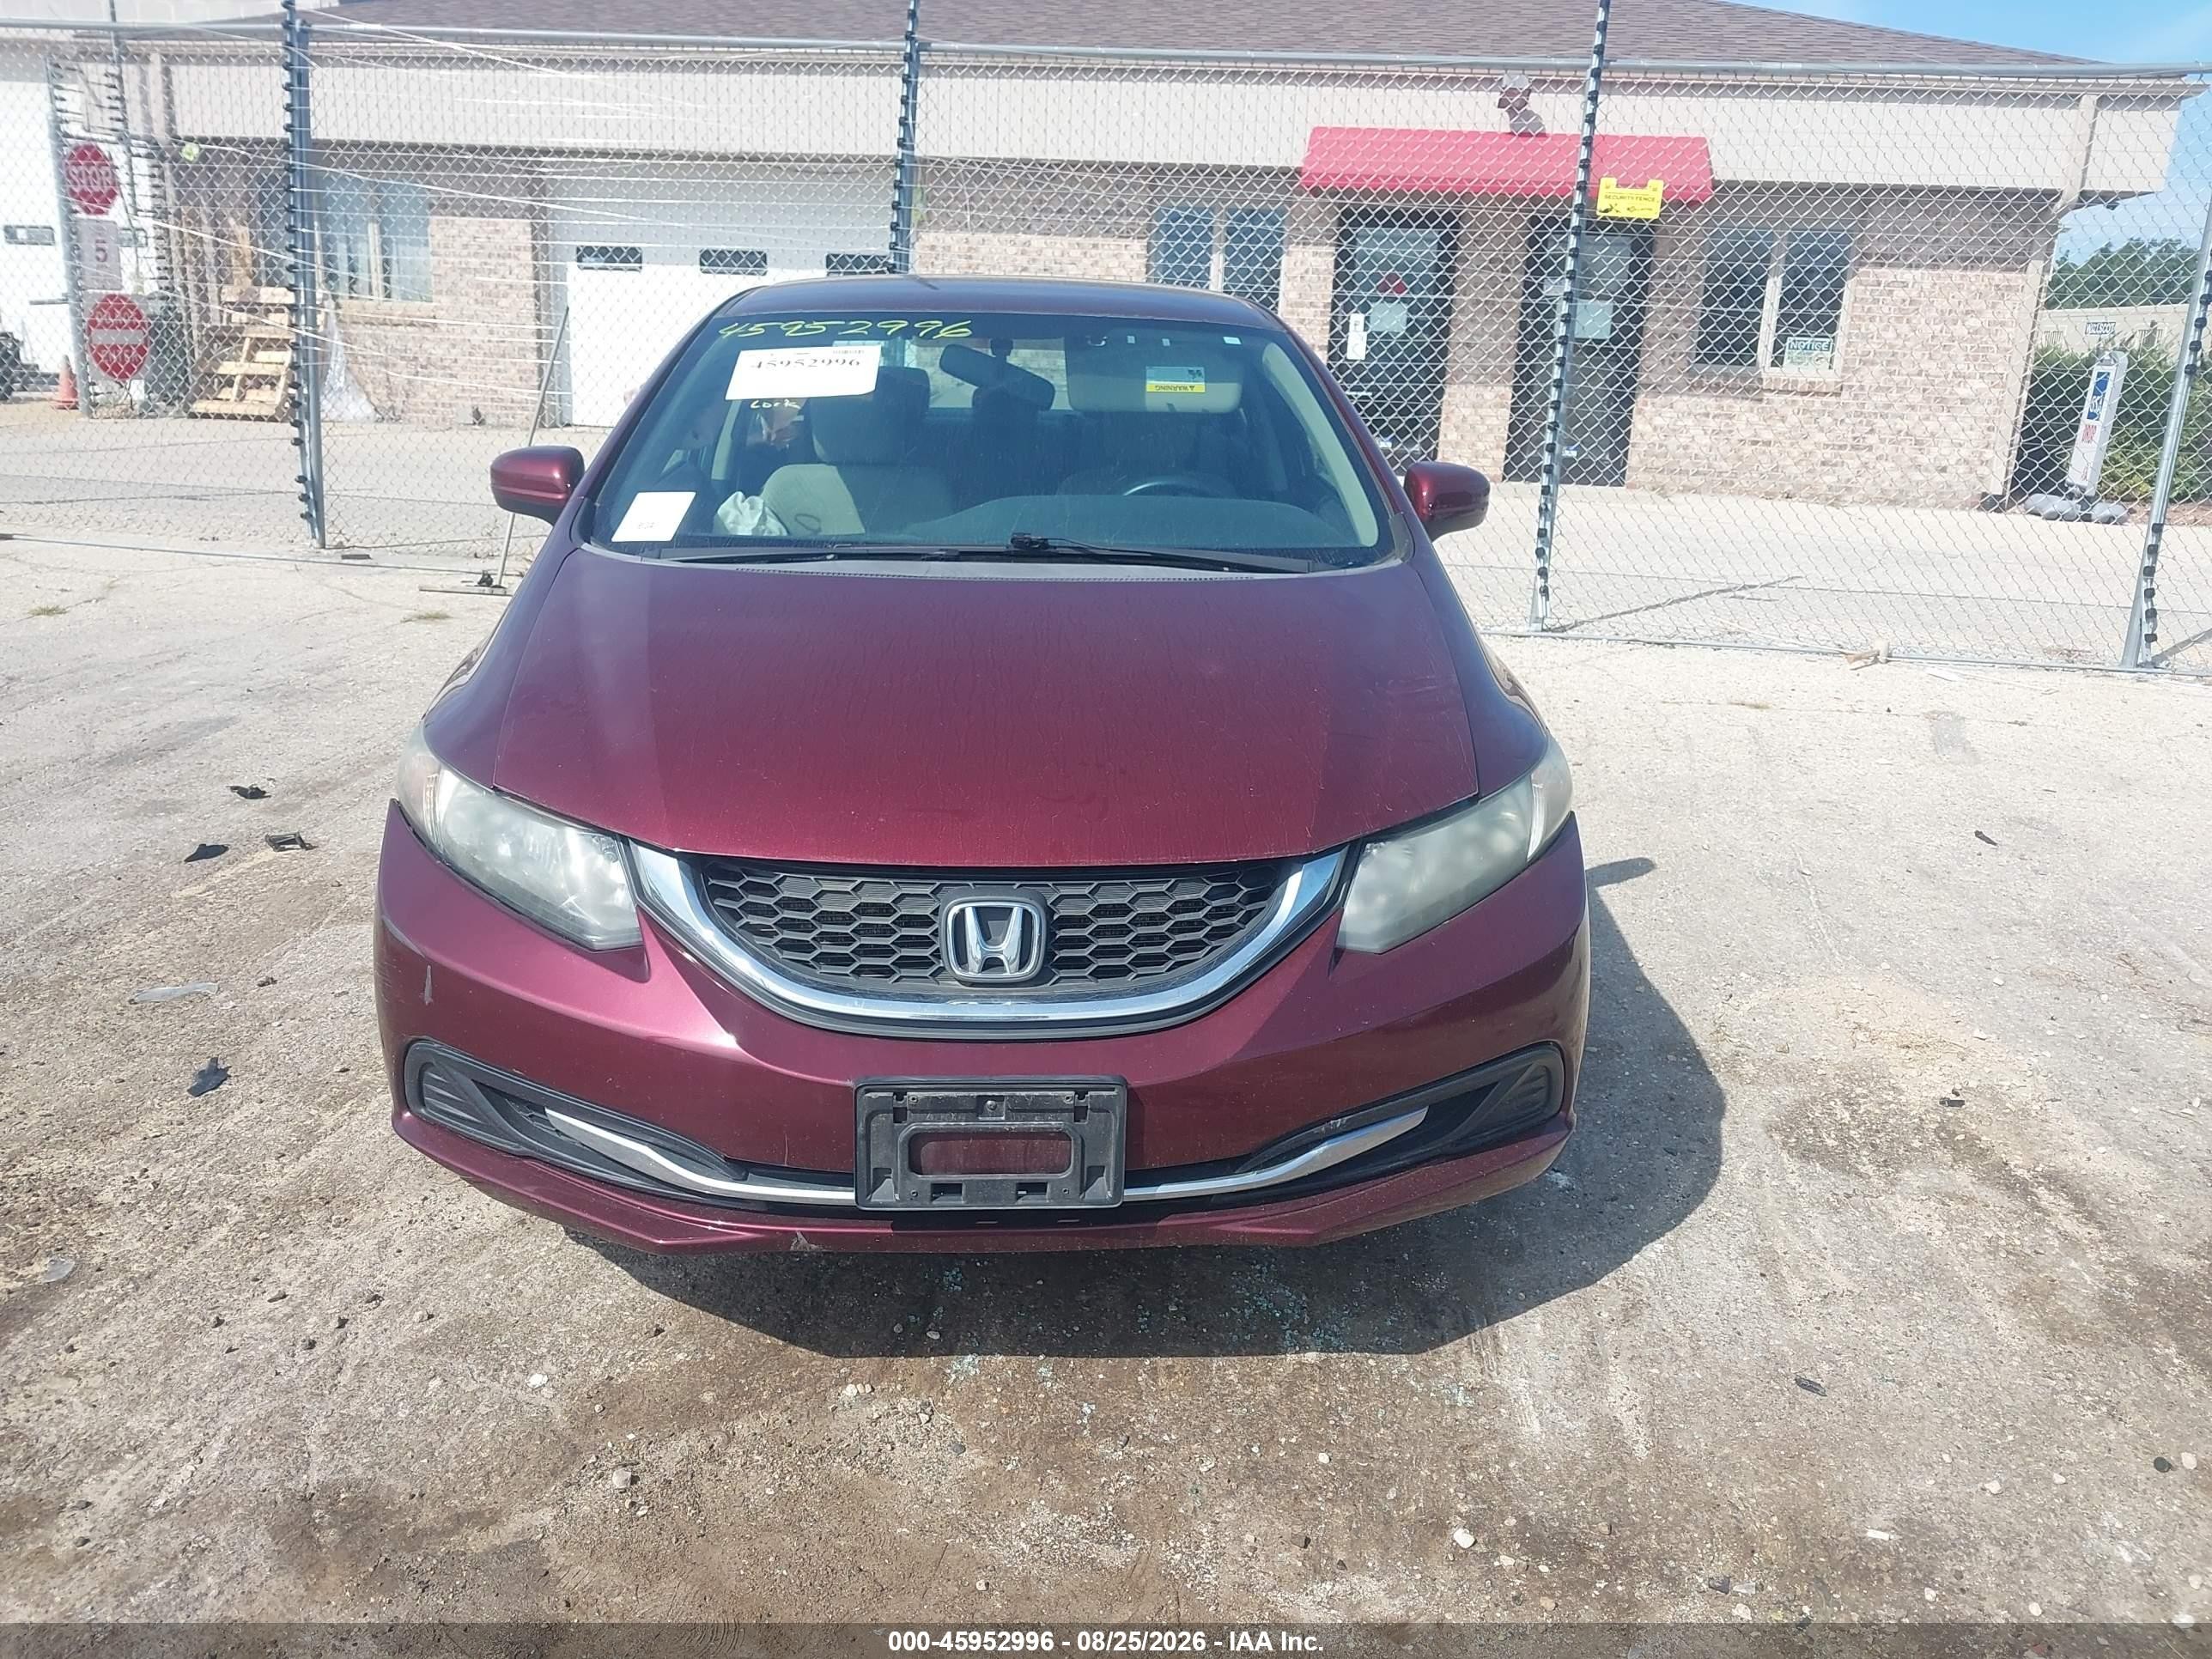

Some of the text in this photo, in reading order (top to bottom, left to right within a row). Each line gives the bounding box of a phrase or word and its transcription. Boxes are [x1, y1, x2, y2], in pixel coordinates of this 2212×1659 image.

[68, 166, 113, 190] STOP
[94, 239, 108, 263] 5
[718, 319, 973, 339] 45952996
[1790, 340, 1828, 350] NOTICE
[750, 357, 861, 369] 45952996
